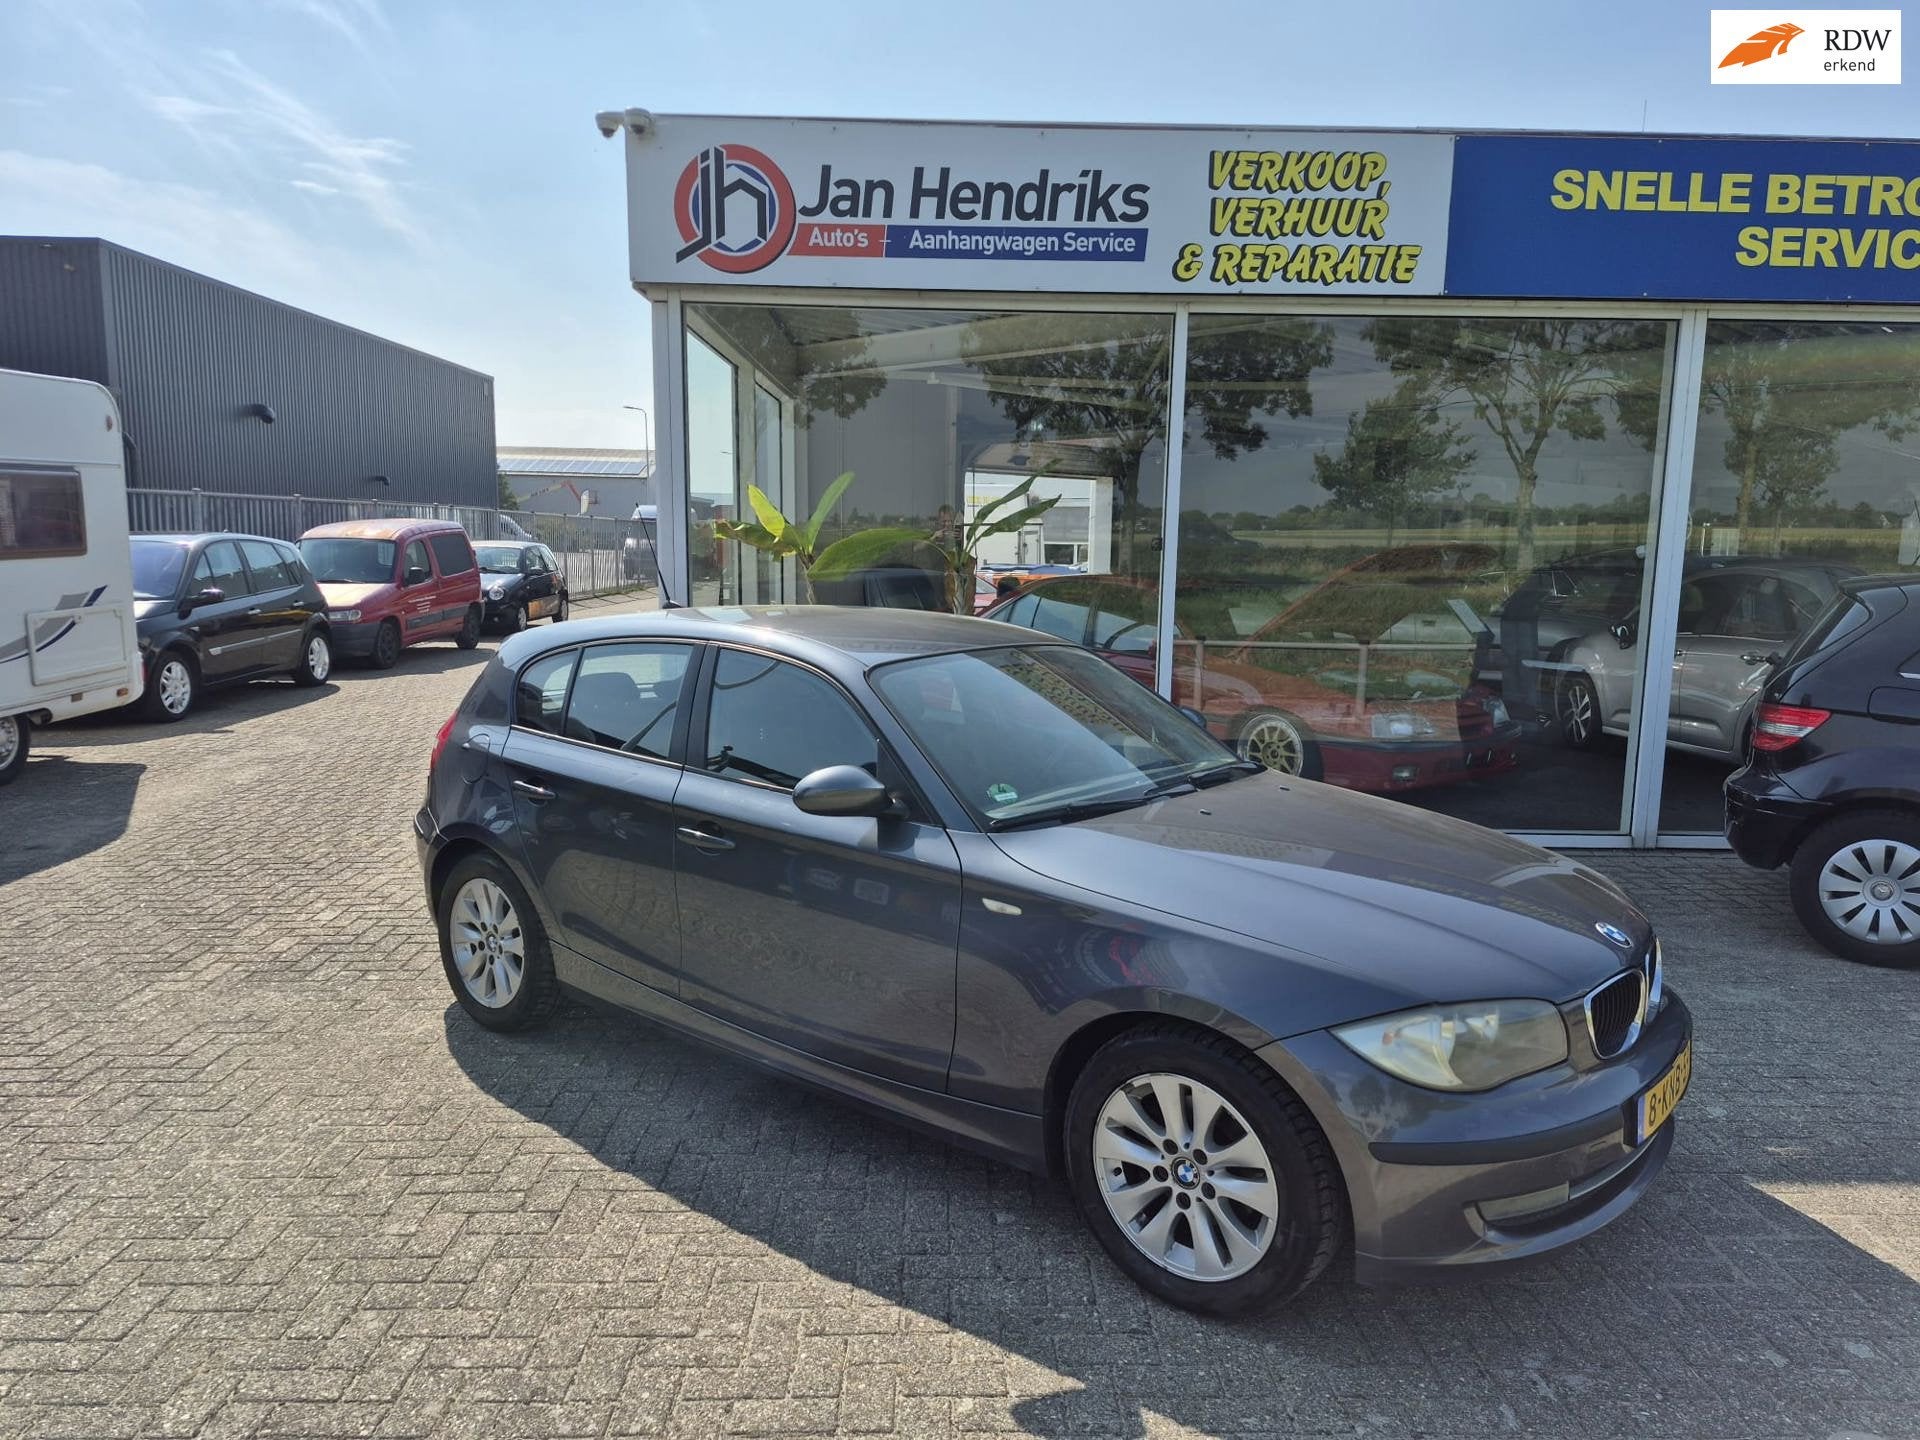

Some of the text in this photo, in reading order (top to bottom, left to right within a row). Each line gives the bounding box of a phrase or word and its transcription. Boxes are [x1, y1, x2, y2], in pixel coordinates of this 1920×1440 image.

[799, 165, 1150, 223] Jan Hendriks
[1209, 150, 1391, 199] VERKOOP,
[1550, 169, 1753, 213] SNELLE
[1210, 197, 1390, 240] VERHUUR
[808, 228, 1136, 255] Auto's Aanhangwagen Service
[1735, 226, 1920, 270] SERVIC
[1172, 243, 1423, 285] & REPARATIE
